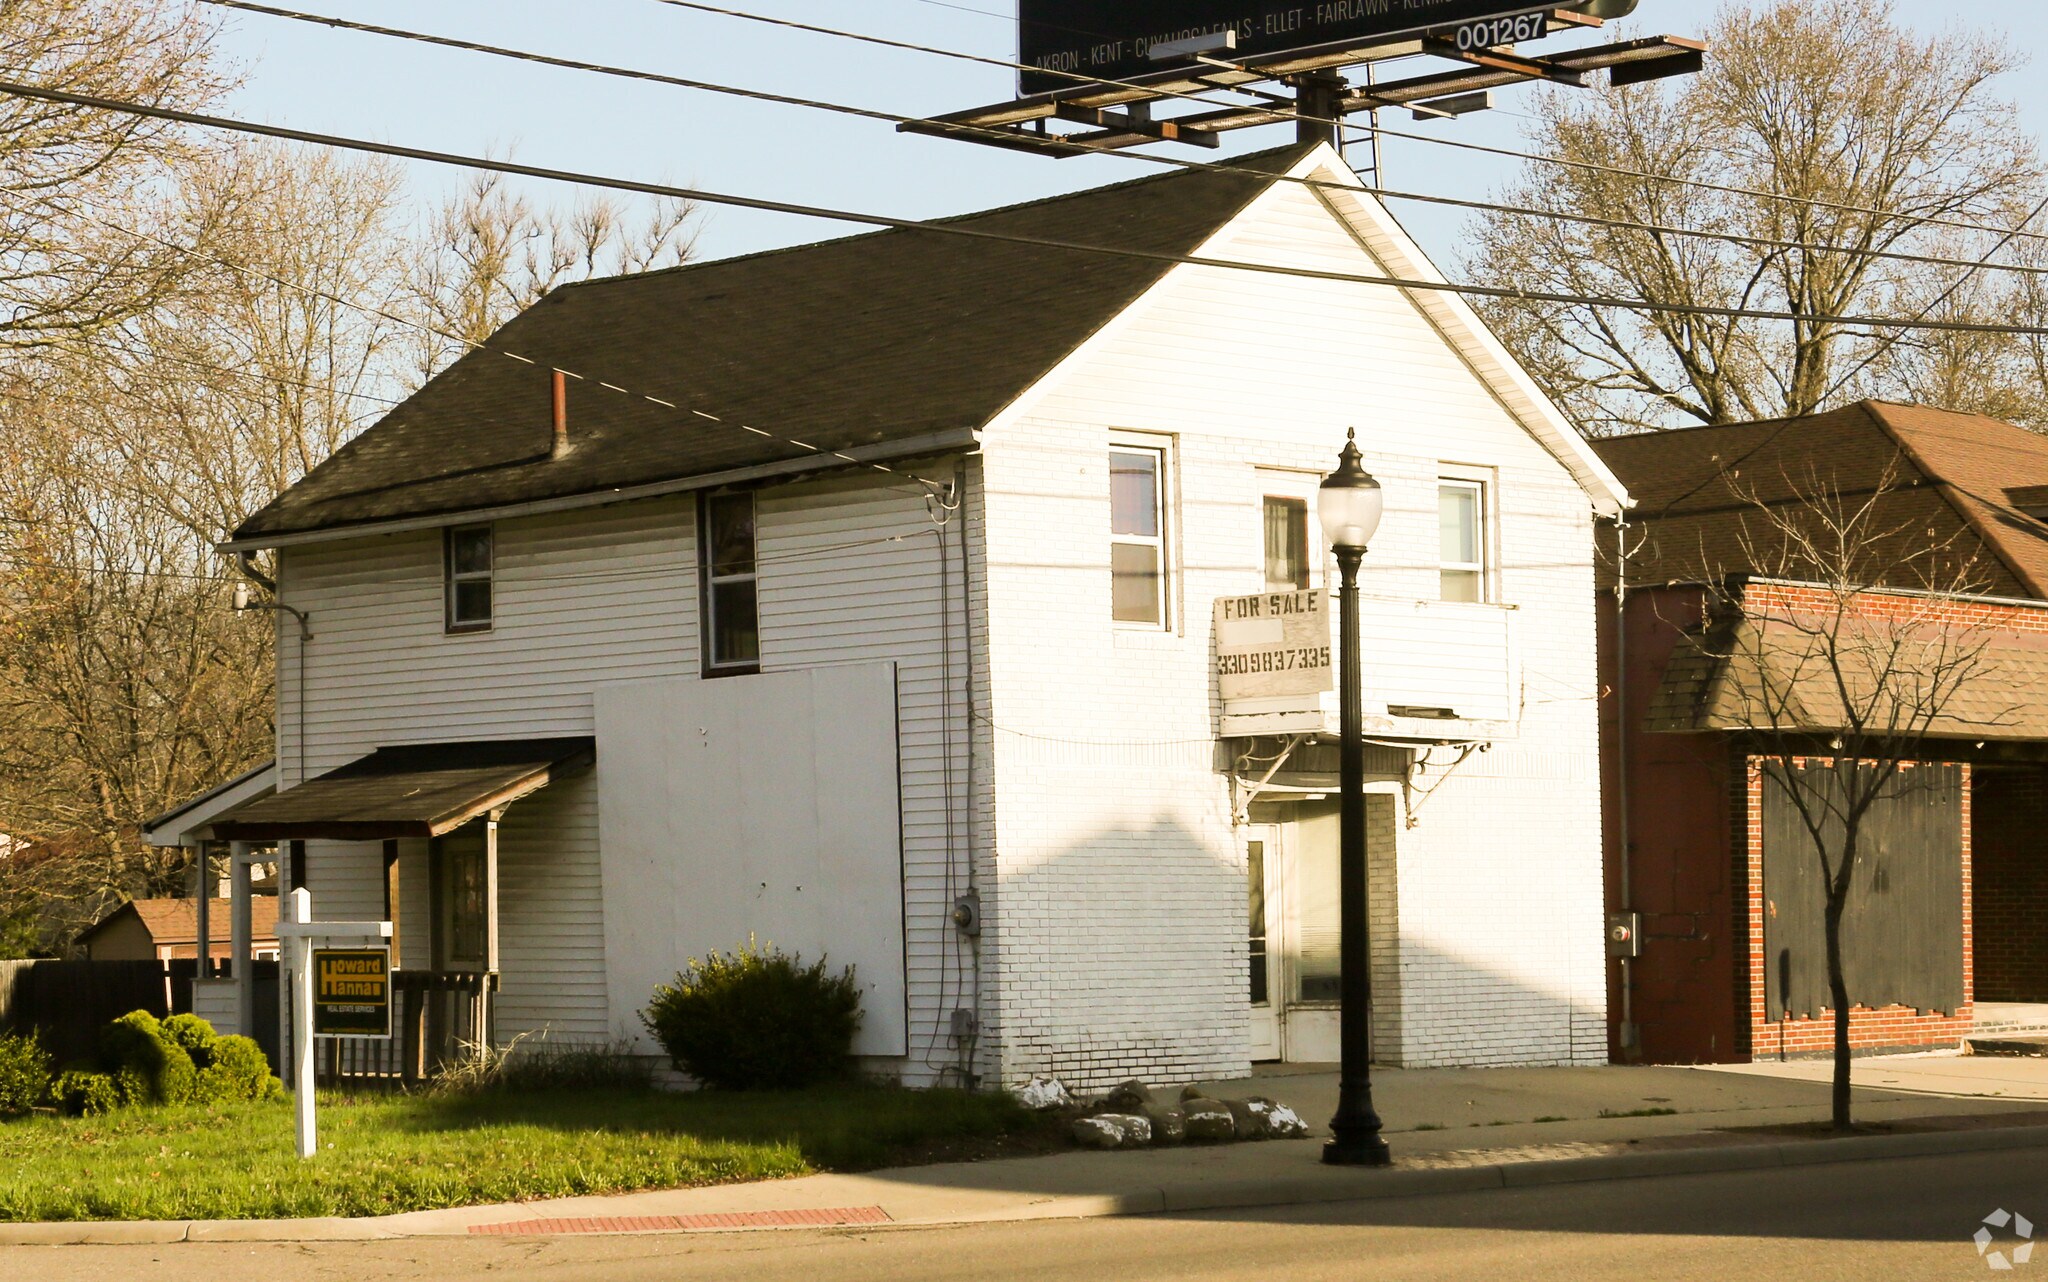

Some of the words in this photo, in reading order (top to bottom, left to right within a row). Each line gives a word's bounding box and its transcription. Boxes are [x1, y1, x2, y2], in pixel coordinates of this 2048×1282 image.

[1035, 50, 1079, 74] AKRON
[1091, 41, 1123, 65] KENT
[1265, 9, 1304, 35] ELLET
[1317, 0, 1389, 25] FAIRLAWN
[1456, 12, 1544, 50] 001267
[1224, 596, 1260, 619] FOR
[1270, 591, 1318, 616] SALE
[1218, 646, 1330, 676] 3309837335
[321, 958, 380, 983] Howard
